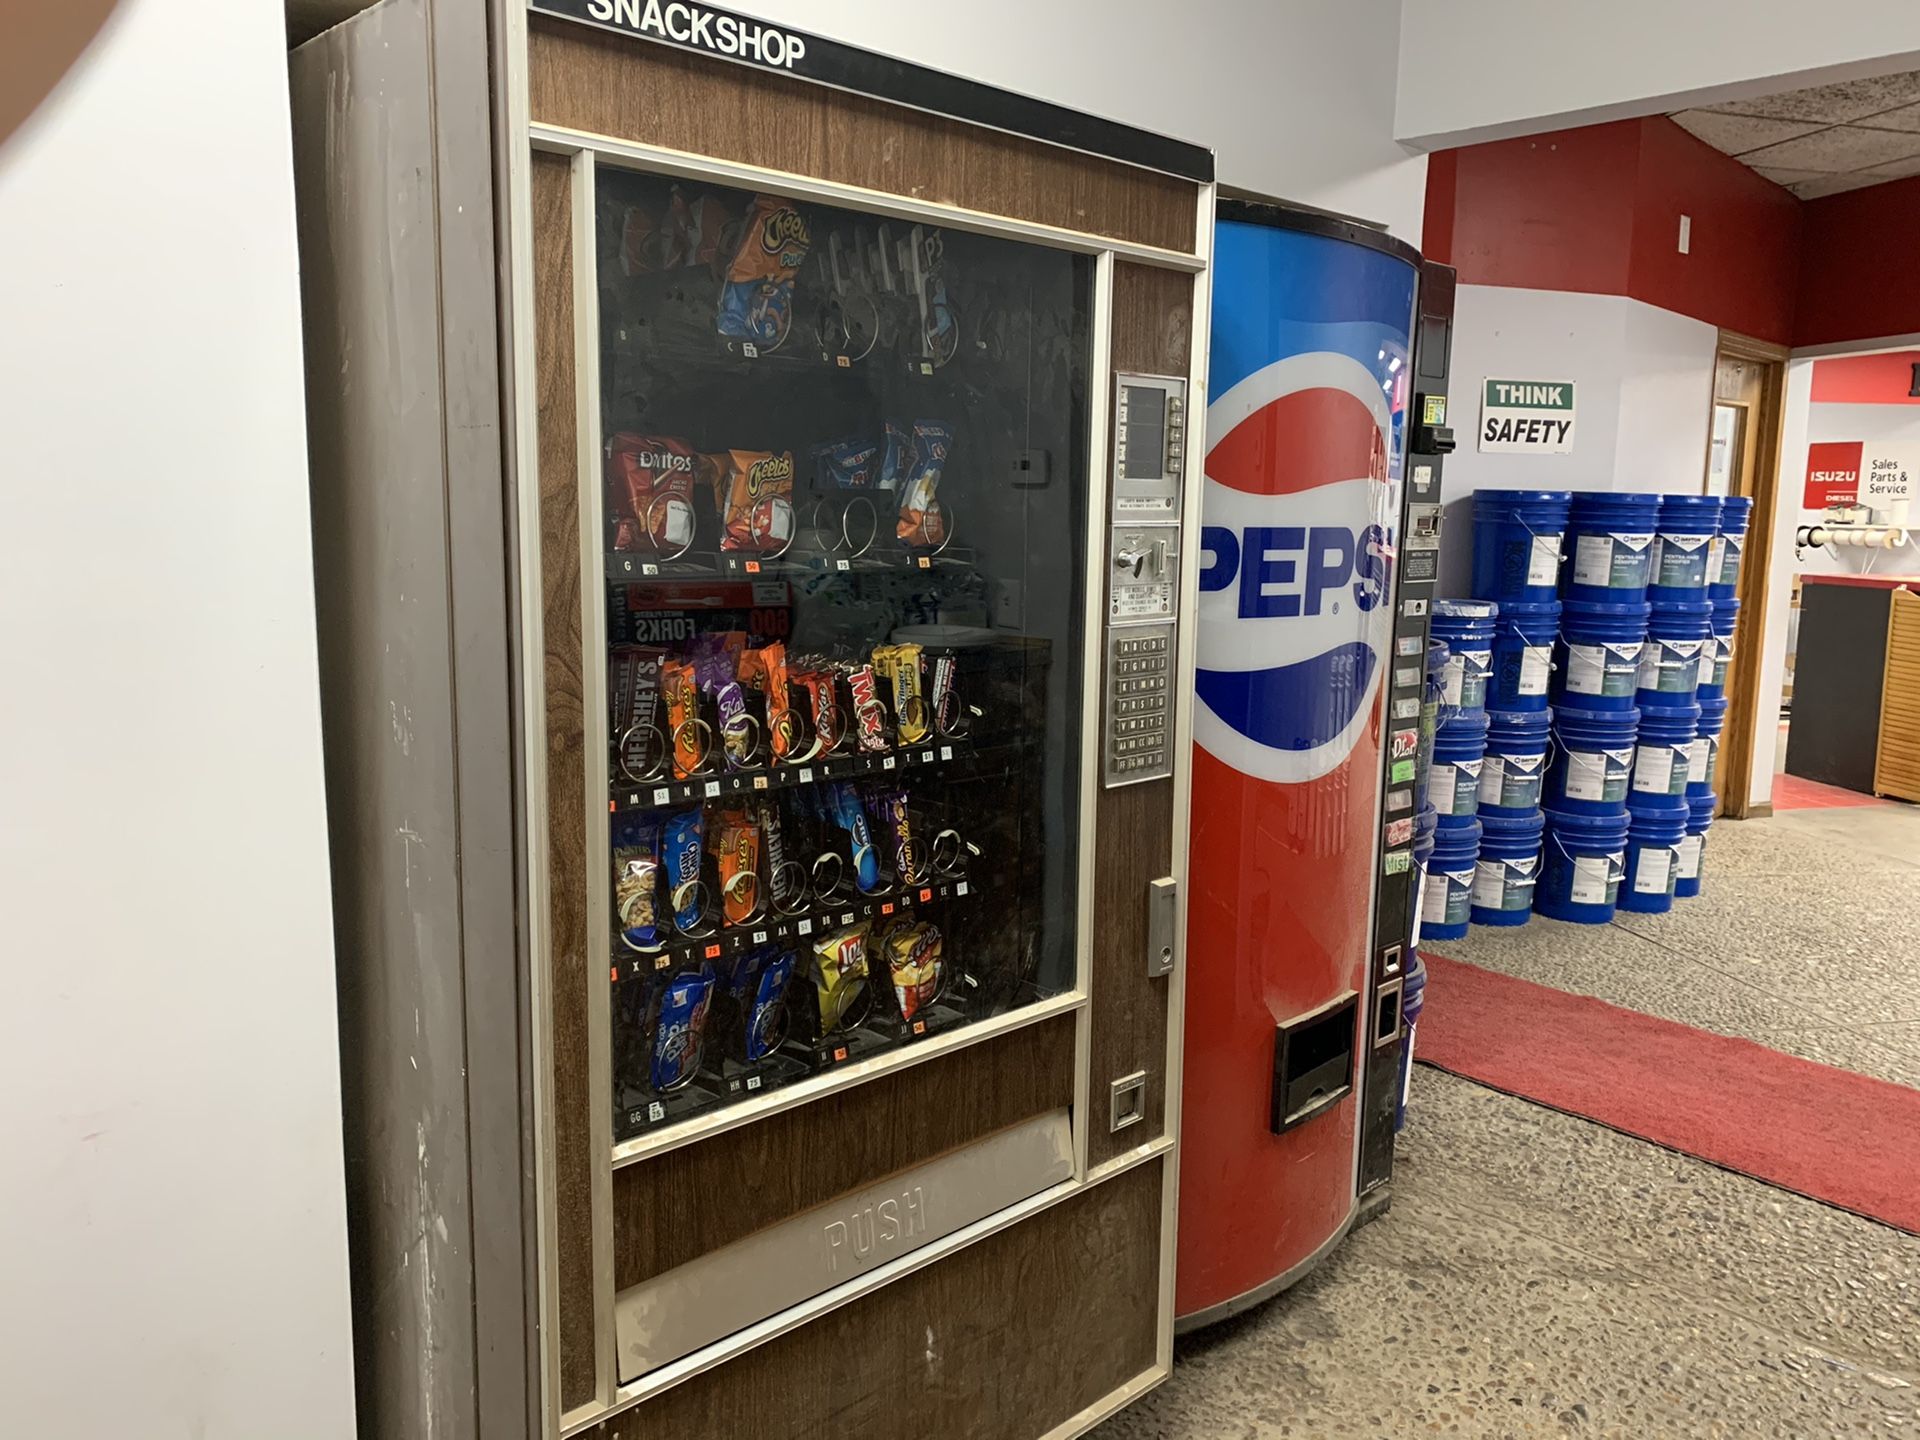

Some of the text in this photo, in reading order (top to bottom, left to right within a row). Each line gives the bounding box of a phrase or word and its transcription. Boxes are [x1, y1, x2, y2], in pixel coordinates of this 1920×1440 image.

[1496, 384, 1563, 406] THINK
[1484, 417, 1572, 445] SAFETY
[640, 450, 693, 473] Doritos
[1872, 459, 1898, 471] Sales
[748, 458, 790, 496] Cheetos
[1810, 471, 1856, 482] ISUZU
[1870, 471, 1908, 483] Parts &
[1825, 494, 1856, 502] DIESEL
[1869, 483, 1908, 495] Service
[1199, 525, 1394, 619] PEPSI
[626, 660, 658, 770] HERSHEY'S
[681, 686, 695, 754] Reese's
[824, 1187, 926, 1272] PUSH
